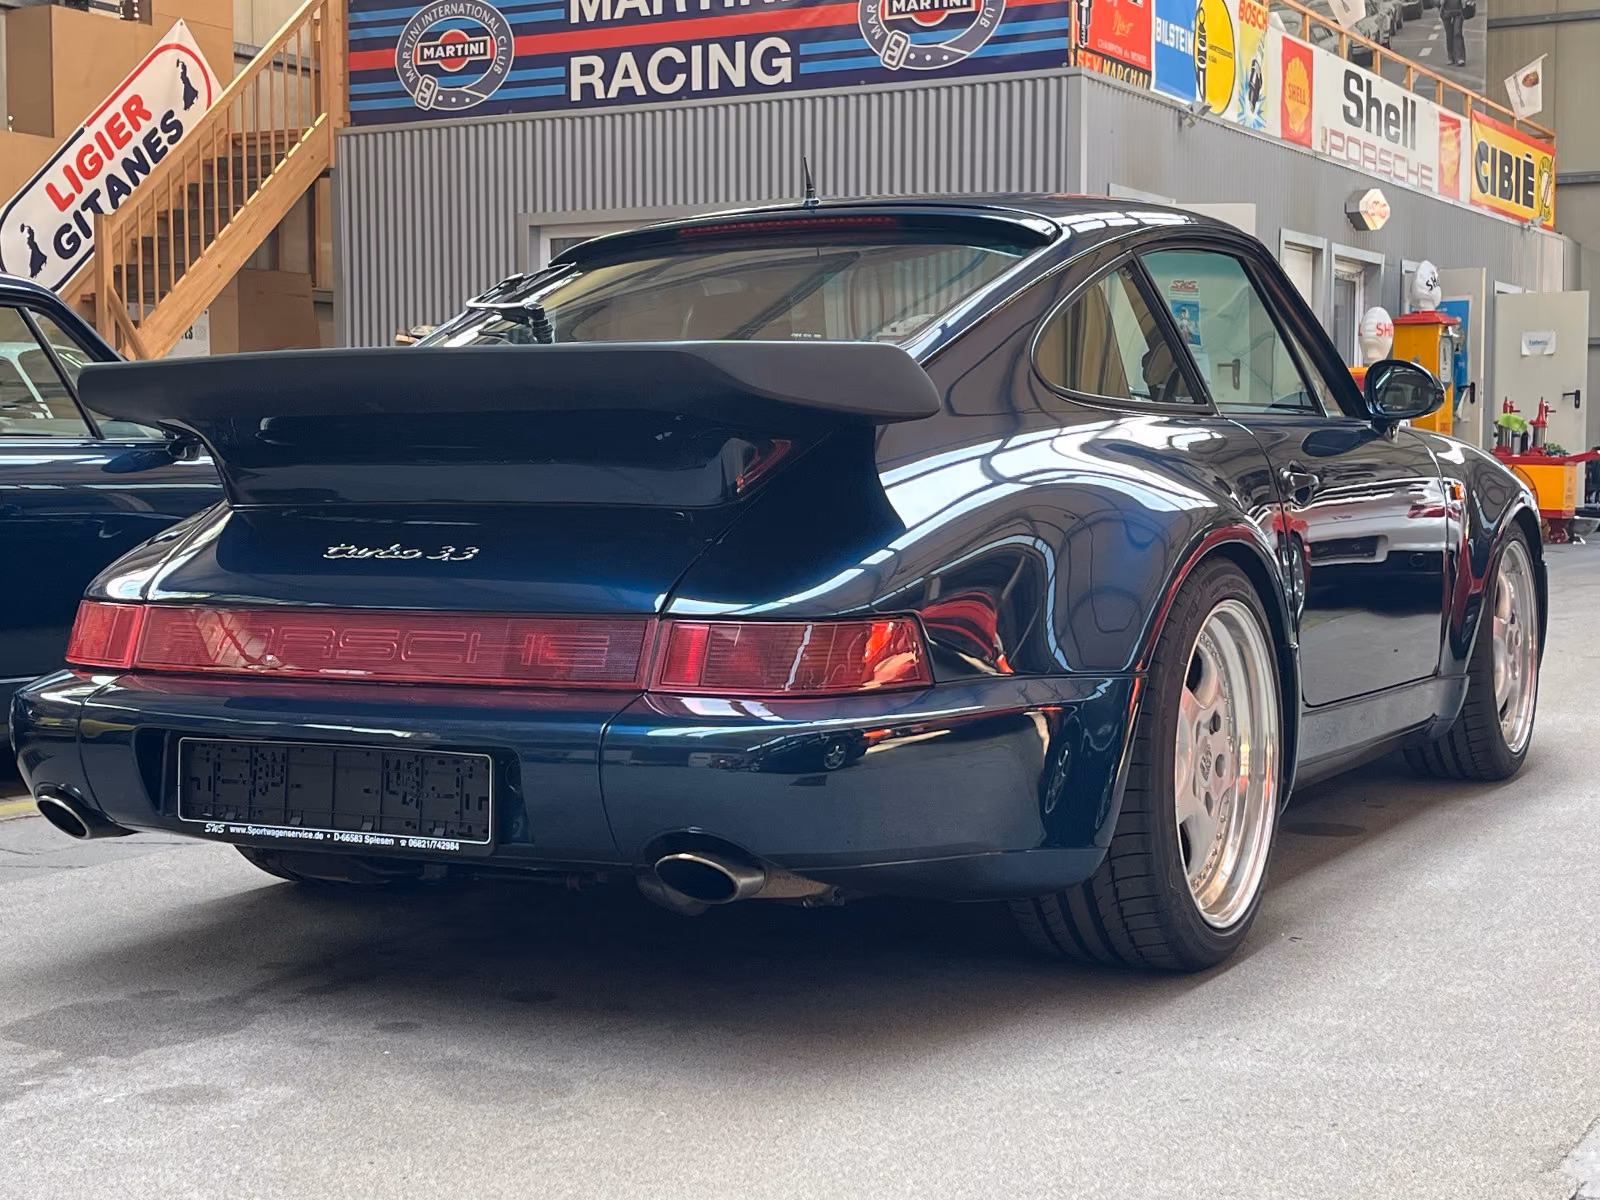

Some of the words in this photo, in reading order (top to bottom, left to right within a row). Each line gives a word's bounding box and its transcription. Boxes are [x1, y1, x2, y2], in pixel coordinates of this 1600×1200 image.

[1156, 16, 1194, 56] BILSTEIN
[1239, 0, 1267, 32] BOSCH
[402, 23, 421, 83] MARTINI
[421, 3, 500, 34] INTERNATIONAL
[493, 36, 507, 74] CLUB
[423, 42, 485, 59] MARTINI
[570, 37, 792, 101] RACING
[1288, 82, 1306, 105] SHELL
[1342, 68, 1417, 151] Shell
[45, 94, 152, 212] LIGIER
[1329, 128, 1433, 191] PORSCHE
[53, 109, 184, 260] GITANES
[323, 543, 423, 559] turbo
[229, 825, 324, 840] www.Sportwagenservice.de
[333, 832, 363, 844] D-66583
